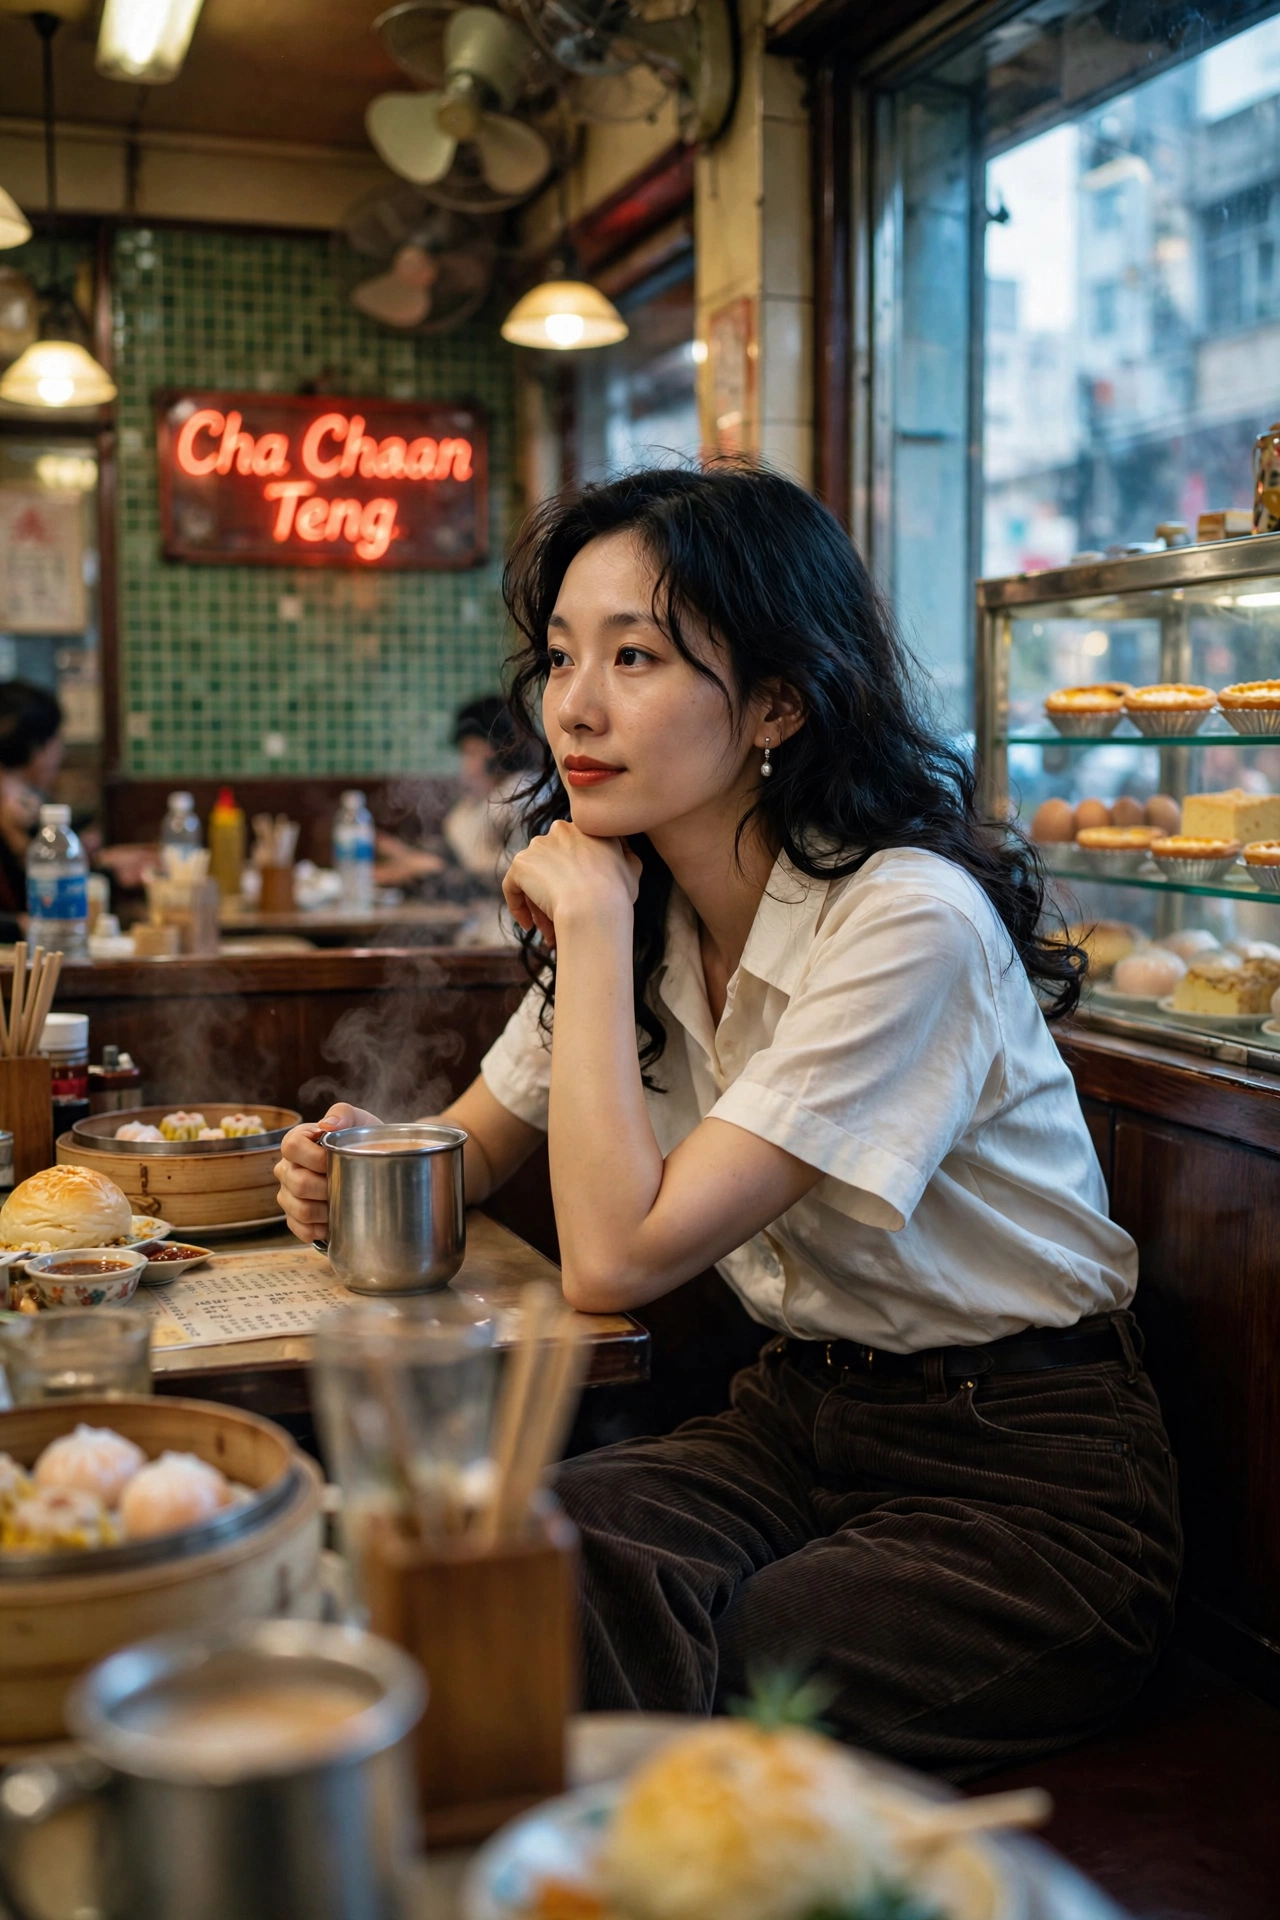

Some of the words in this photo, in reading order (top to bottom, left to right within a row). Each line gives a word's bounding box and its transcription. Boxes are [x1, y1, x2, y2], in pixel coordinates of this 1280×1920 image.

[177, 408, 290, 477] Cha
[301, 412, 473, 482] Chaan
[263, 480, 399, 560] Teng
